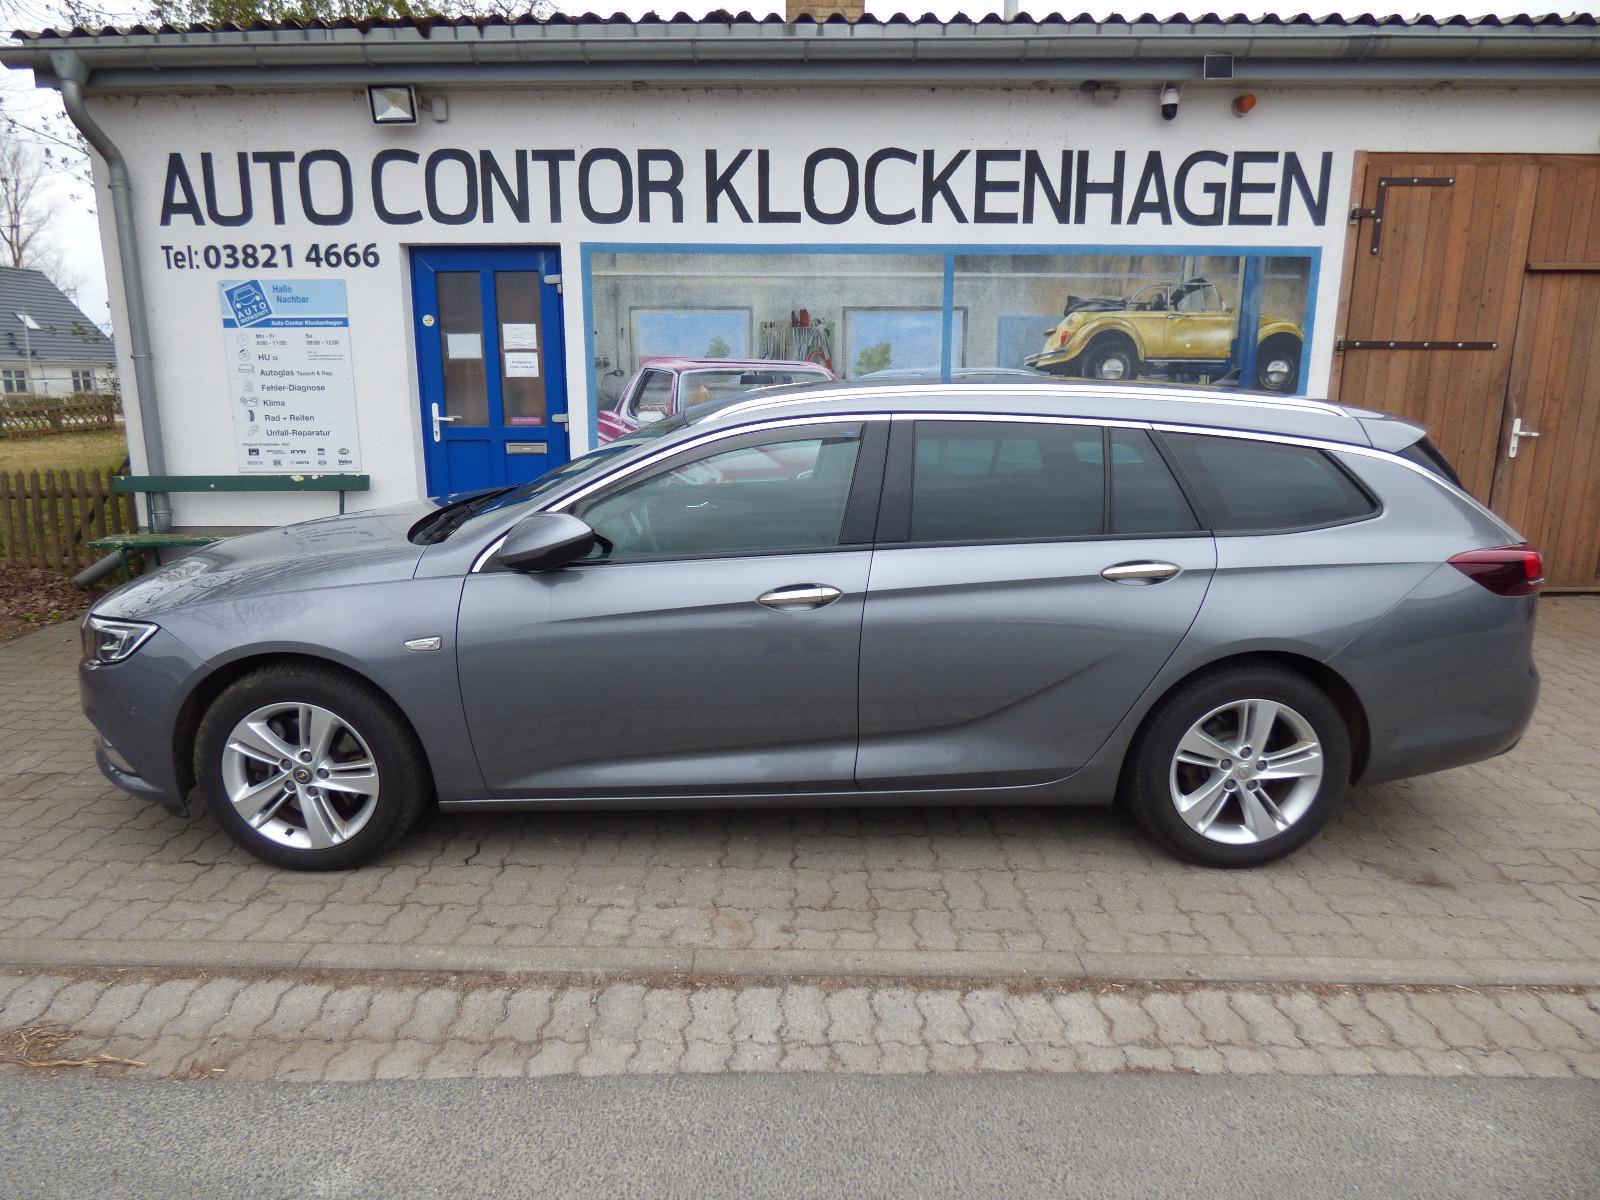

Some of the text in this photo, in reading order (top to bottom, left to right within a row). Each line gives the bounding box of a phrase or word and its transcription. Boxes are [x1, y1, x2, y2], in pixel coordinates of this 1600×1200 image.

[160, 147, 1333, 227] AUTO CONTOR KLOCKENHAGEN
[162, 243, 380, 270] Tel: 03821 4666
[272, 285, 293, 294] Hallo
[276, 295, 309, 304] Nachbar
[238, 301, 267, 319] AUTO
[258, 353, 271, 361] HU
[260, 369, 295, 378] Autoglas
[261, 384, 326, 393] Fehler-Diagnose
[263, 399, 286, 407] Klima
[264, 414, 281, 422] Rad
[289, 414, 315, 422] Reifen
[266, 429, 331, 438] Unfall-Reparatur
